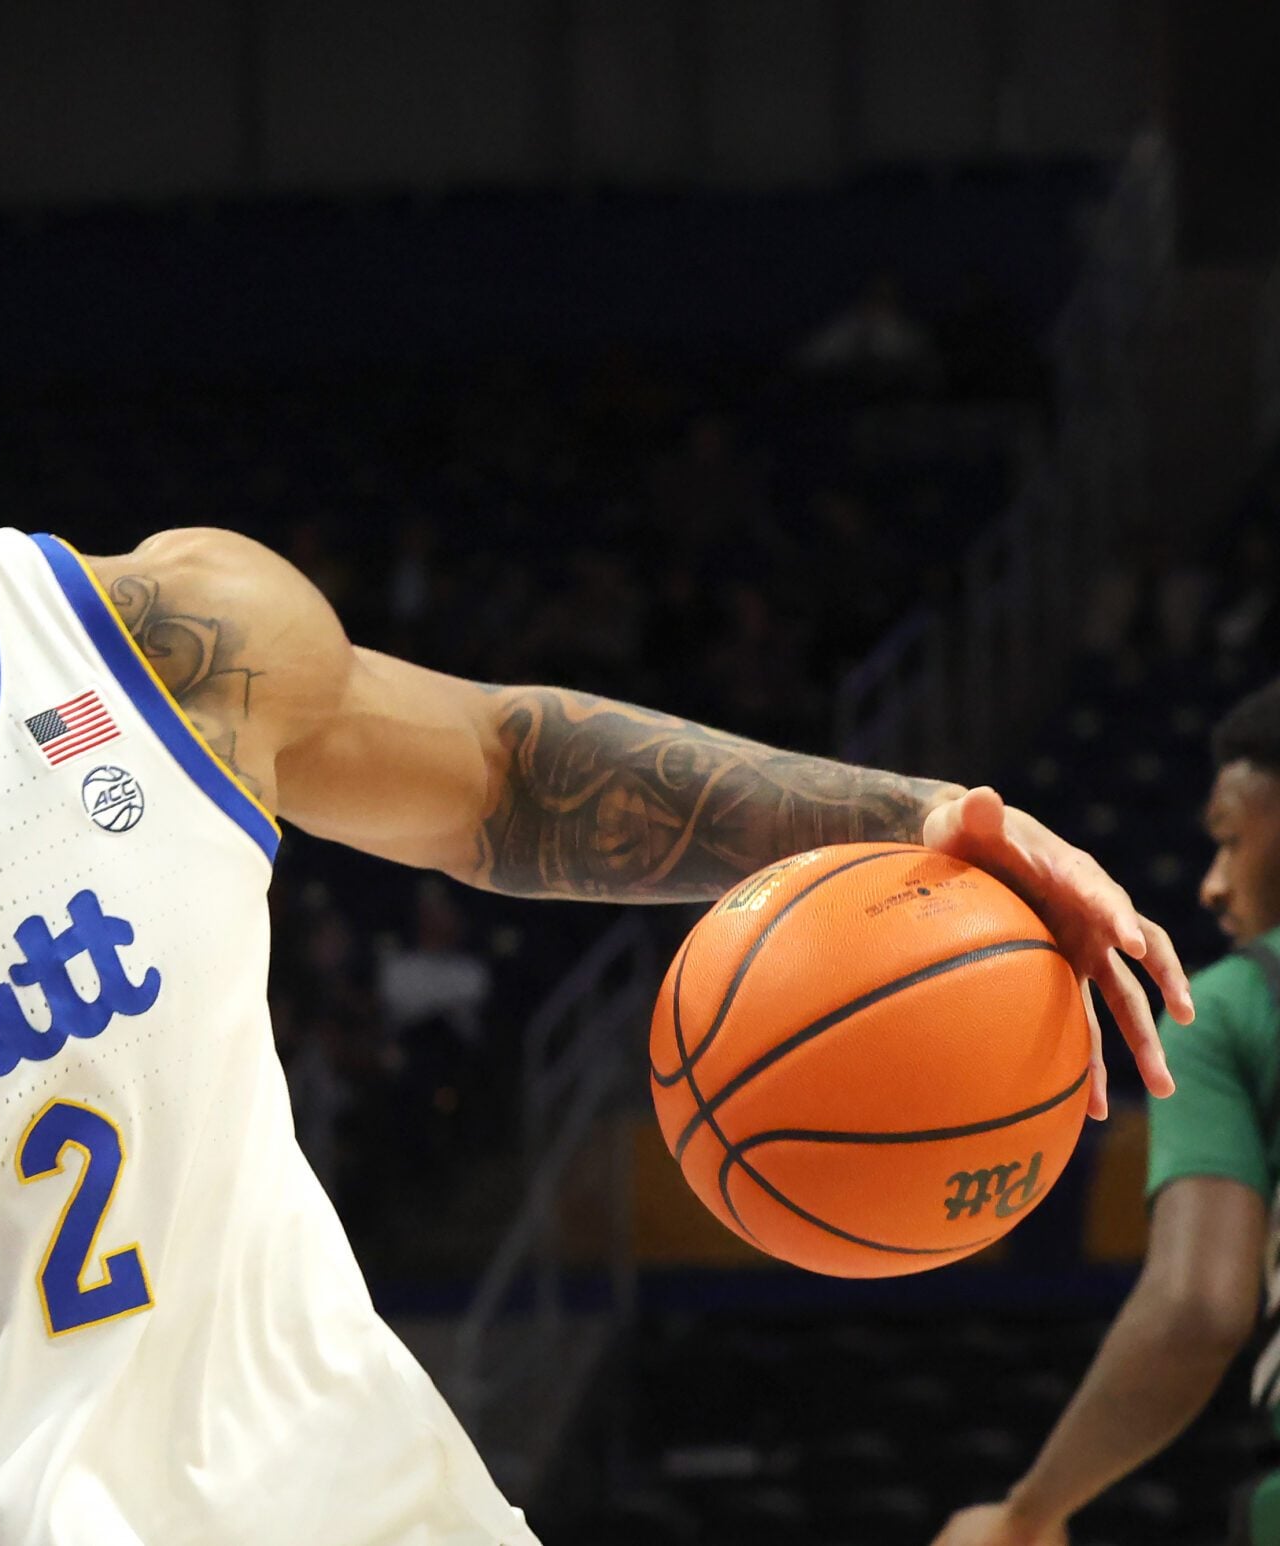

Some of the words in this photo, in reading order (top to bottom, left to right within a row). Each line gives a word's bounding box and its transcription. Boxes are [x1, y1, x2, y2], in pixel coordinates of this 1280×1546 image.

[93, 777, 136, 810] ACC
[14, 1097, 155, 1338] 2
[944, 1150, 1046, 1222] Pitt
